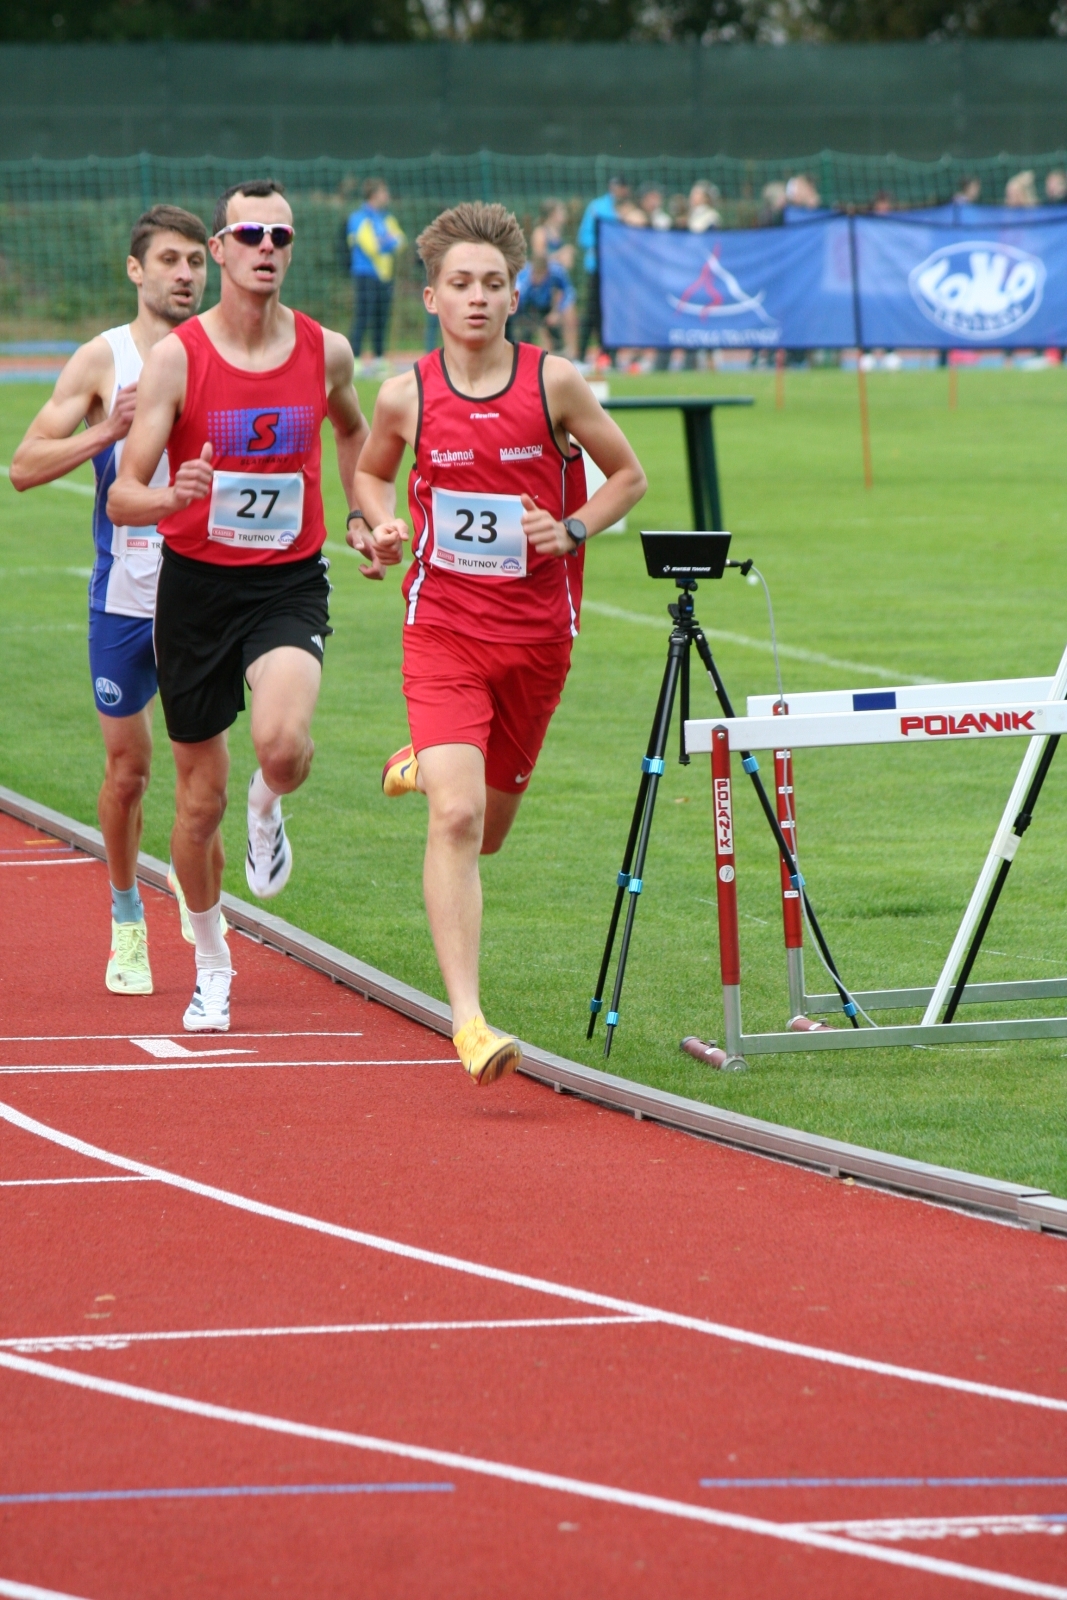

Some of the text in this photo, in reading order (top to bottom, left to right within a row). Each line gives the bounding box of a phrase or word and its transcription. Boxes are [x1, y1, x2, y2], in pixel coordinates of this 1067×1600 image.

[248, 412, 279, 451] S
[499, 444, 543, 456] MARATON
[236, 488, 280, 519] 27
[237, 533, 276, 542] TRUTNOV
[454, 508, 498, 544] 23
[457, 557, 498, 568] TRUTNOV
[899, 710, 1036, 737] POLANIK
[716, 780, 731, 849] POLANIK
